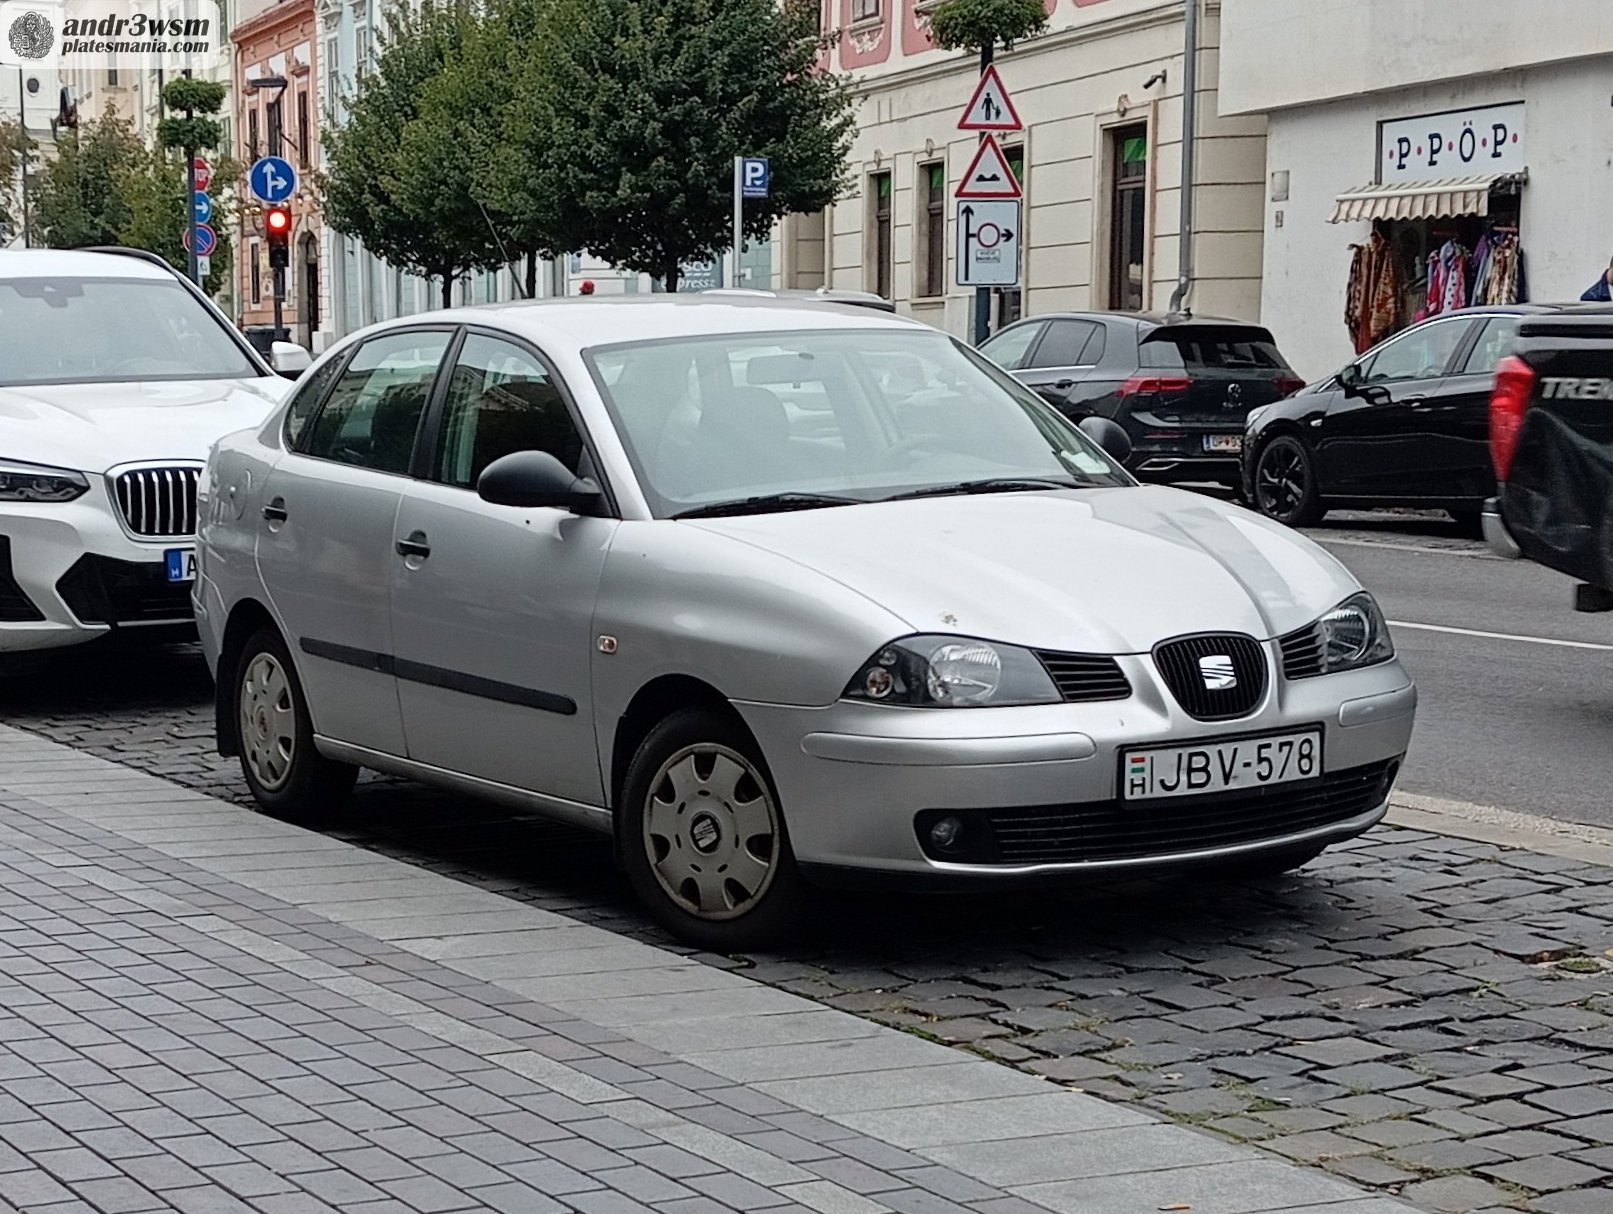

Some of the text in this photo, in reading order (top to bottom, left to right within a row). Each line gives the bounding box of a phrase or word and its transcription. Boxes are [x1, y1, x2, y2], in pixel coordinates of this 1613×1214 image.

[745, 161, 765, 186] P
[171, 567, 180, 578] H
[1129, 737, 1314, 797] H JBV-578
